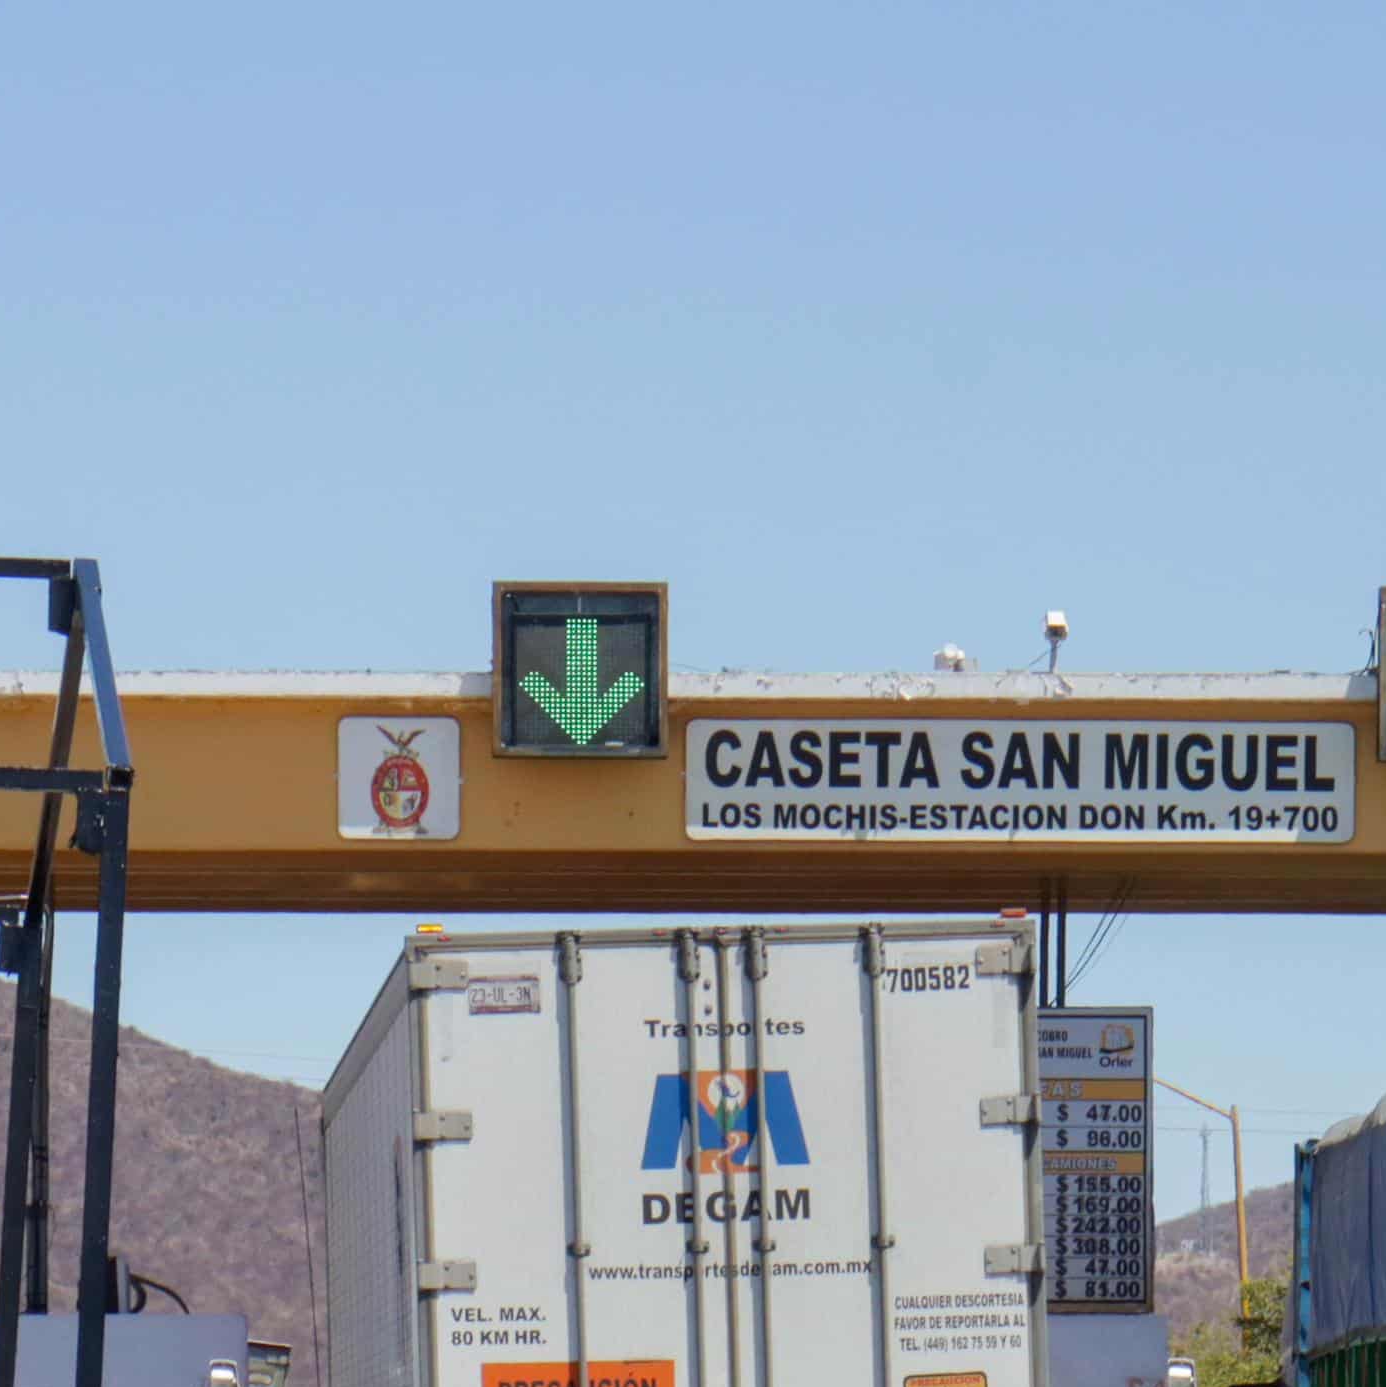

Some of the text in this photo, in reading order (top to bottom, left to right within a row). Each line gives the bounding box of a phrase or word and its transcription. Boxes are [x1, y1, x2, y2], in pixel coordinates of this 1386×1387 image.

[704, 729, 1336, 793] CASETA SAN MIGUEL
[701, 802, 1339, 833] LOS MOCHIS-ESTACION DON Km. 19+700
[885, 964, 971, 993] 700582
[1056, 1046, 1093, 1060] MIGUEL
[1056, 1103, 1142, 1123] $ 47.00
[1056, 1128, 1069, 1149] $
[1056, 1174, 1069, 1194] $
[894, 1295, 953, 1310] CUALQUIER
[450, 1306, 547, 1323] VEL. MAX.
[894, 1313, 1026, 1331] FAVOR DE REPORTARLA AL
[451, 1329, 547, 1346] 80 KM HR.
